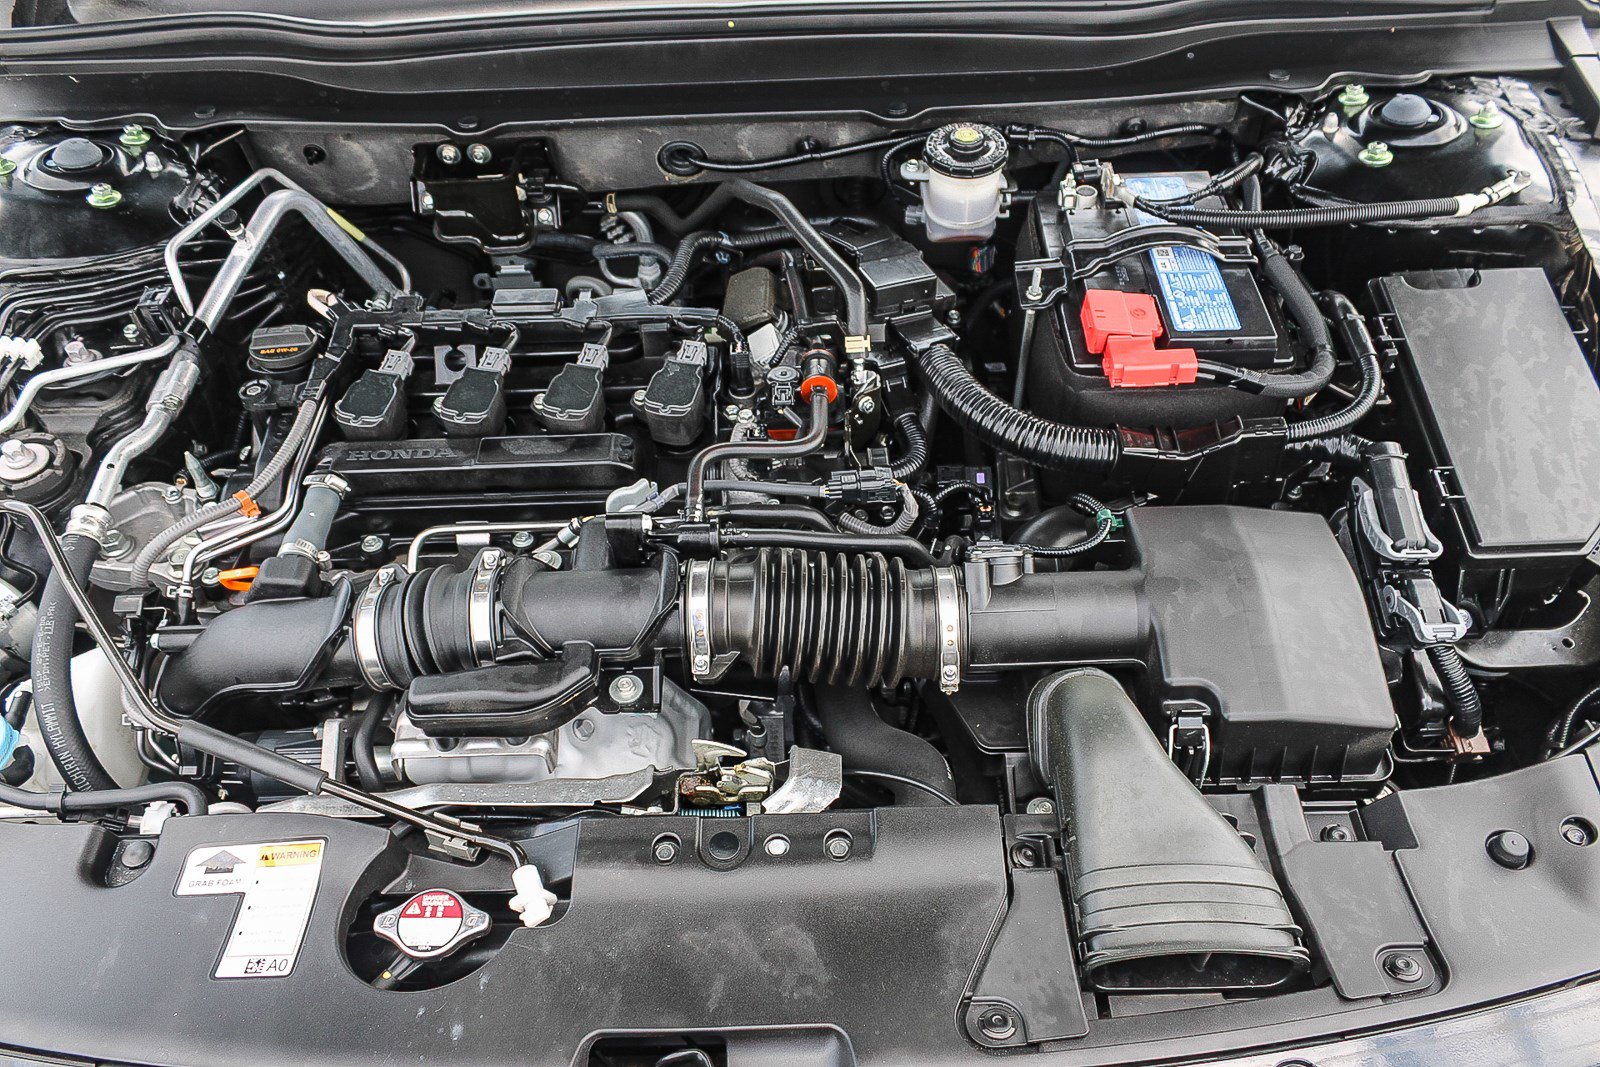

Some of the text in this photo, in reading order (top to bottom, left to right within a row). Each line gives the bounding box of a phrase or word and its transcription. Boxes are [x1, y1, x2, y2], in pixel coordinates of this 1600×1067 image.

[346, 448, 458, 461] HONDA
[41, 703, 94, 792] NICHIRIN HYLAMMIT
[271, 849, 317, 860] WARNING
[188, 878, 214, 888] GRAB
